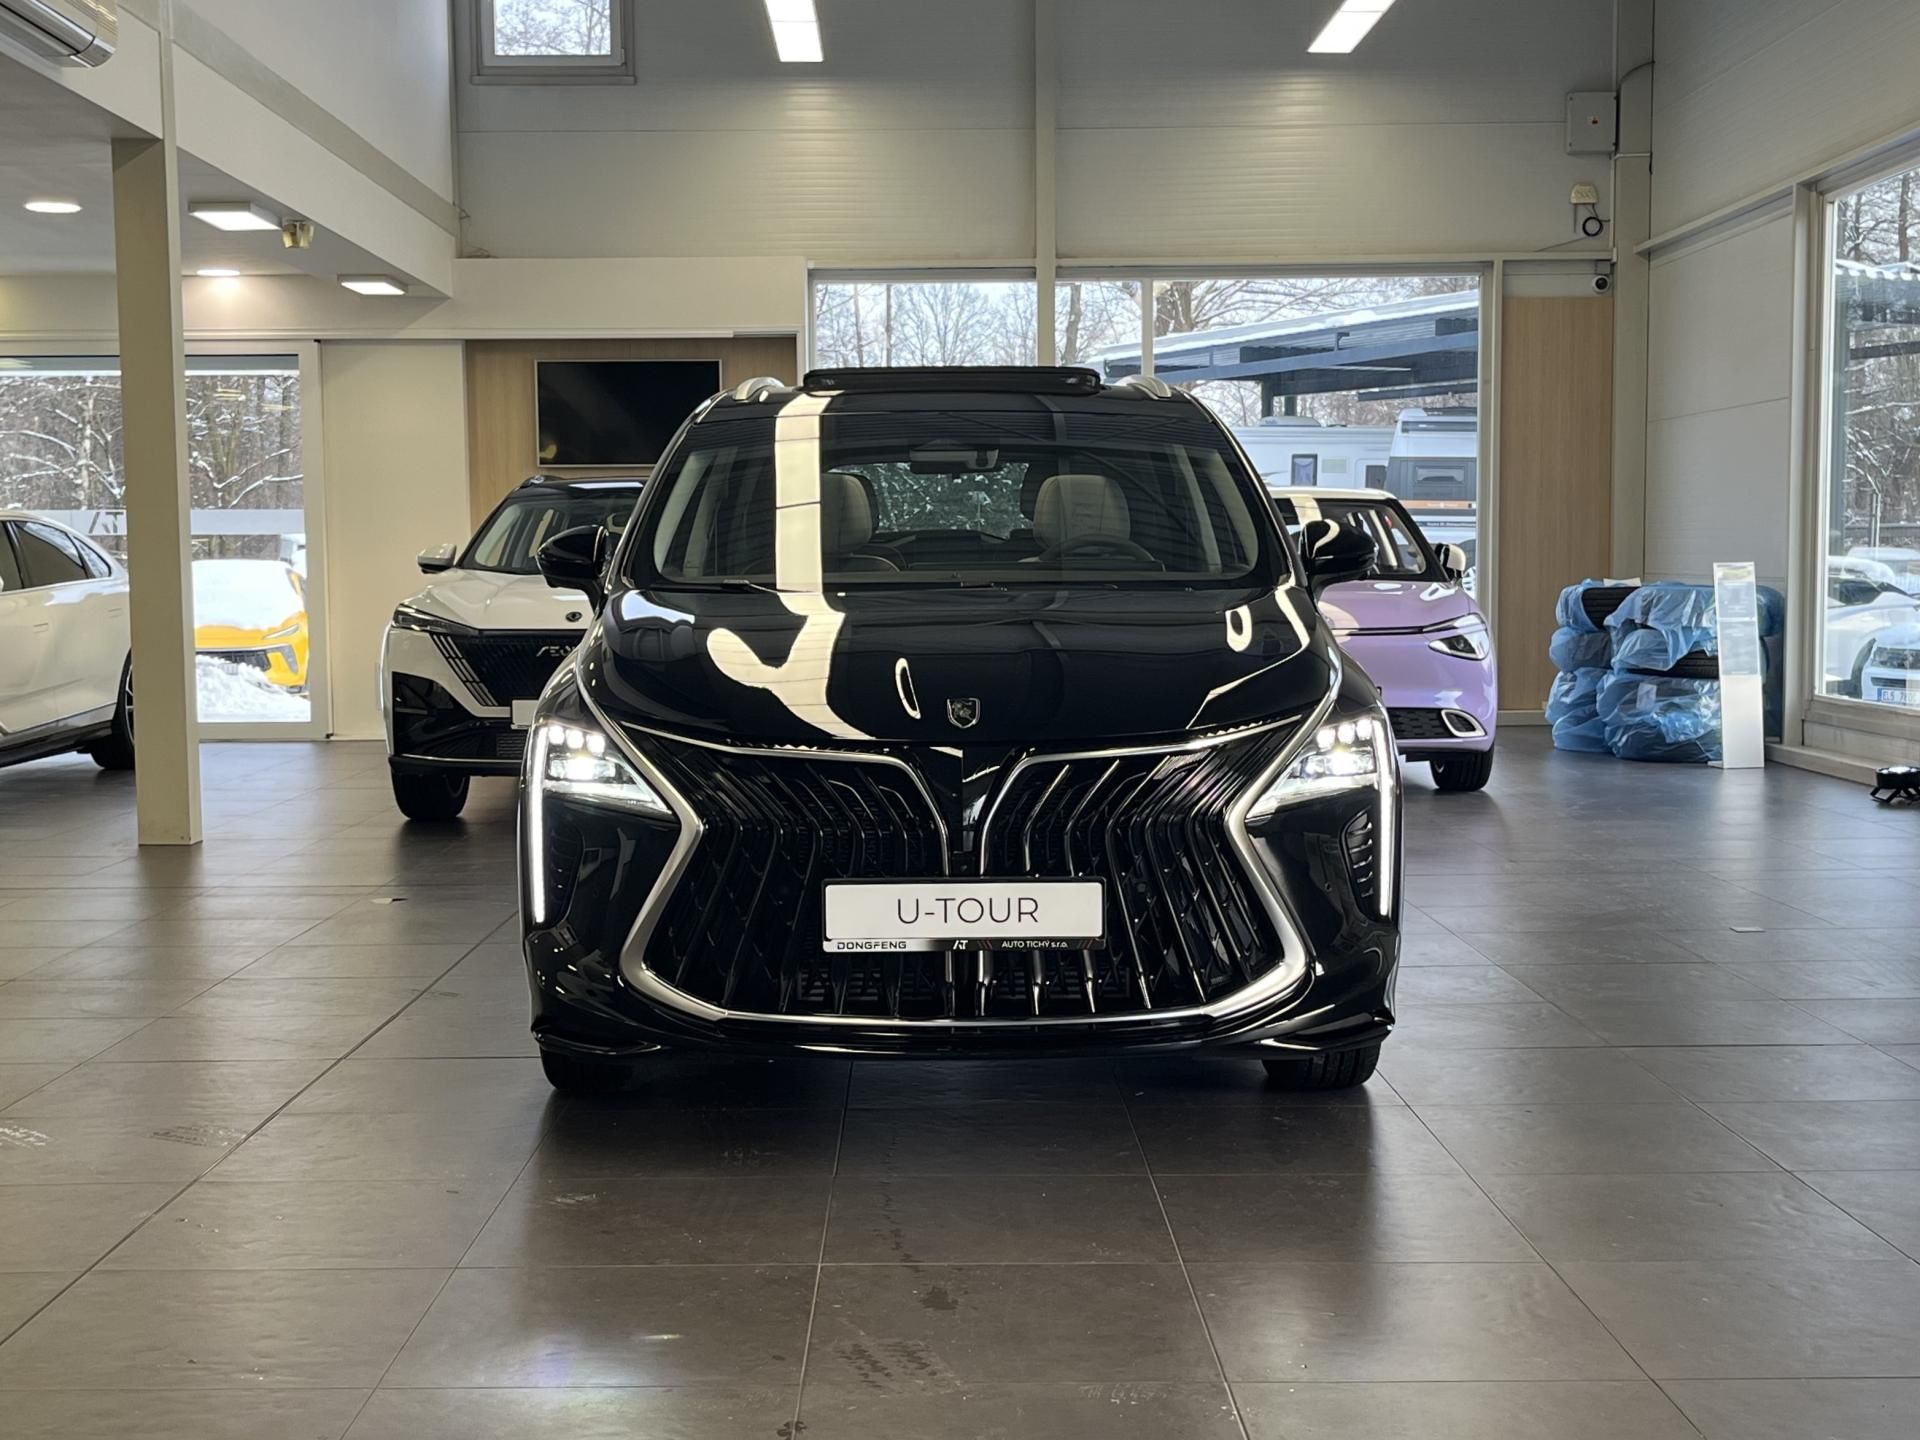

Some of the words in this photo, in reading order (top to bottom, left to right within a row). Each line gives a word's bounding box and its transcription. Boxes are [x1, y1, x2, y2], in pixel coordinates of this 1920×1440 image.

[897, 897, 1039, 924] U-TOUR
[837, 941, 907, 950] DONGFENG
[1001, 940, 1025, 948] AUTO
[1026, 939, 1050, 948] TICHÝ
[1051, 940, 1068, 948] s.r.o.
